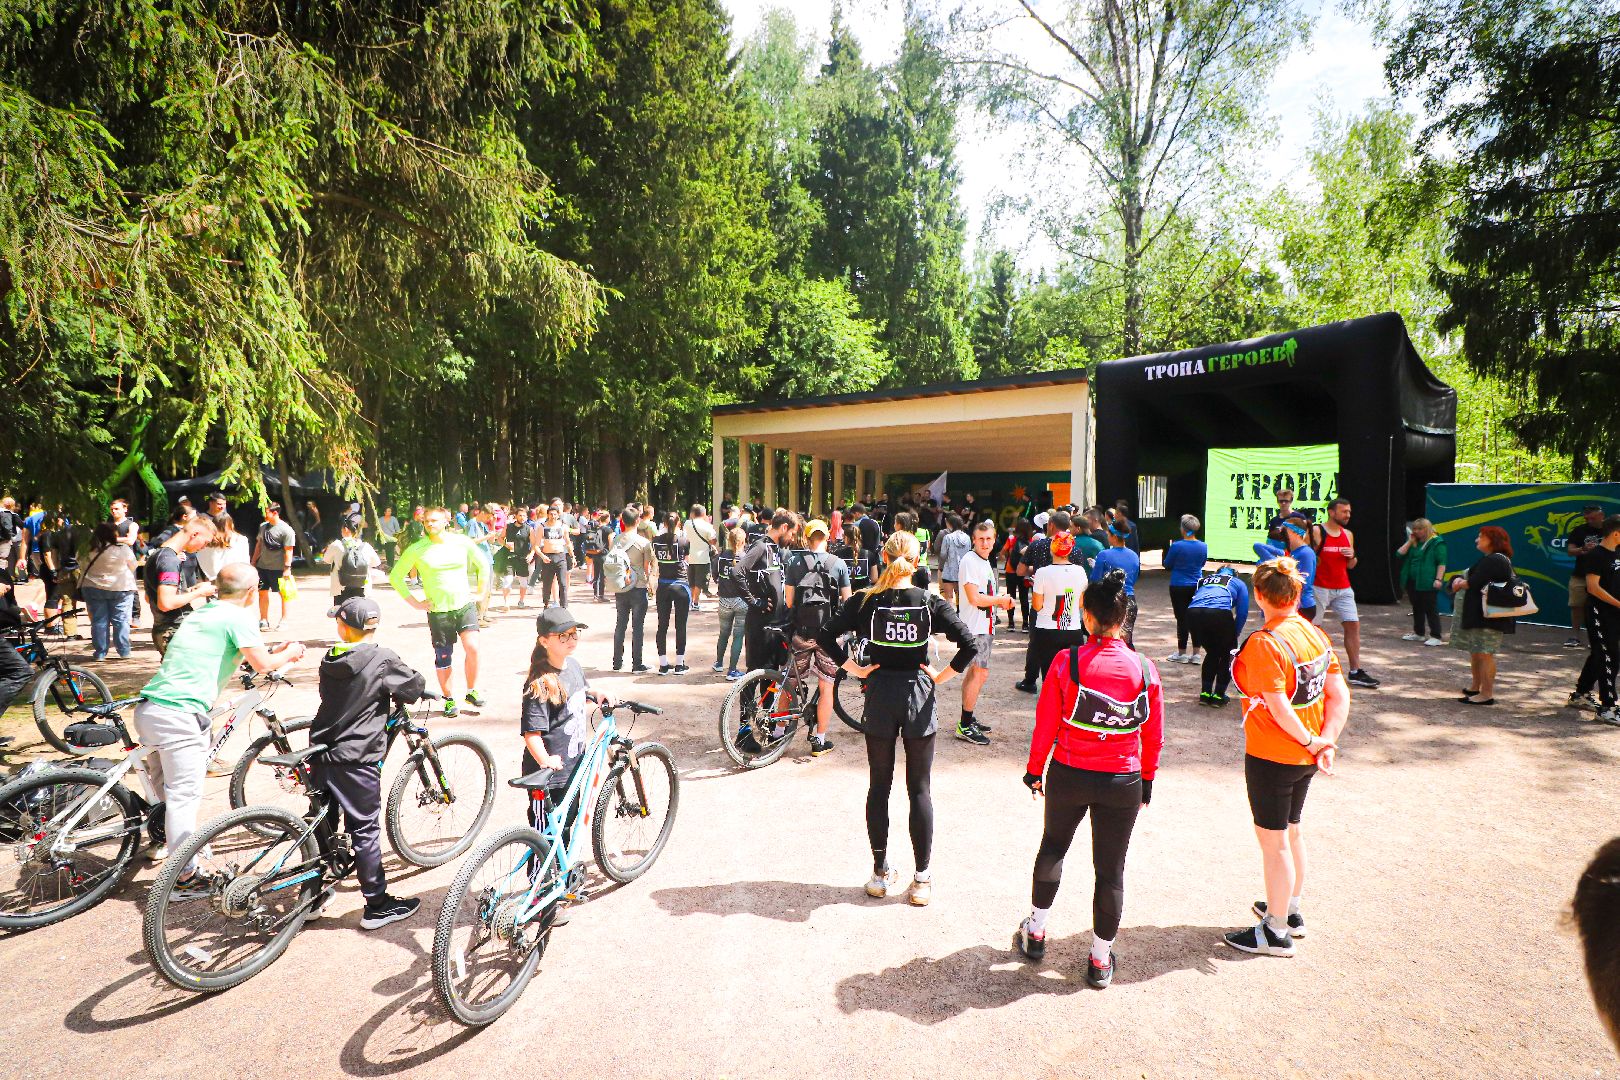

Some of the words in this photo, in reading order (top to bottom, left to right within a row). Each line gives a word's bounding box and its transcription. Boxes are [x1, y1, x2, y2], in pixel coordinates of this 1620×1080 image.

[1145, 359, 1205, 381] ТРОПА
[1208, 346, 1287, 373] ГЕРОЕВ
[885, 621, 918, 642] 558
